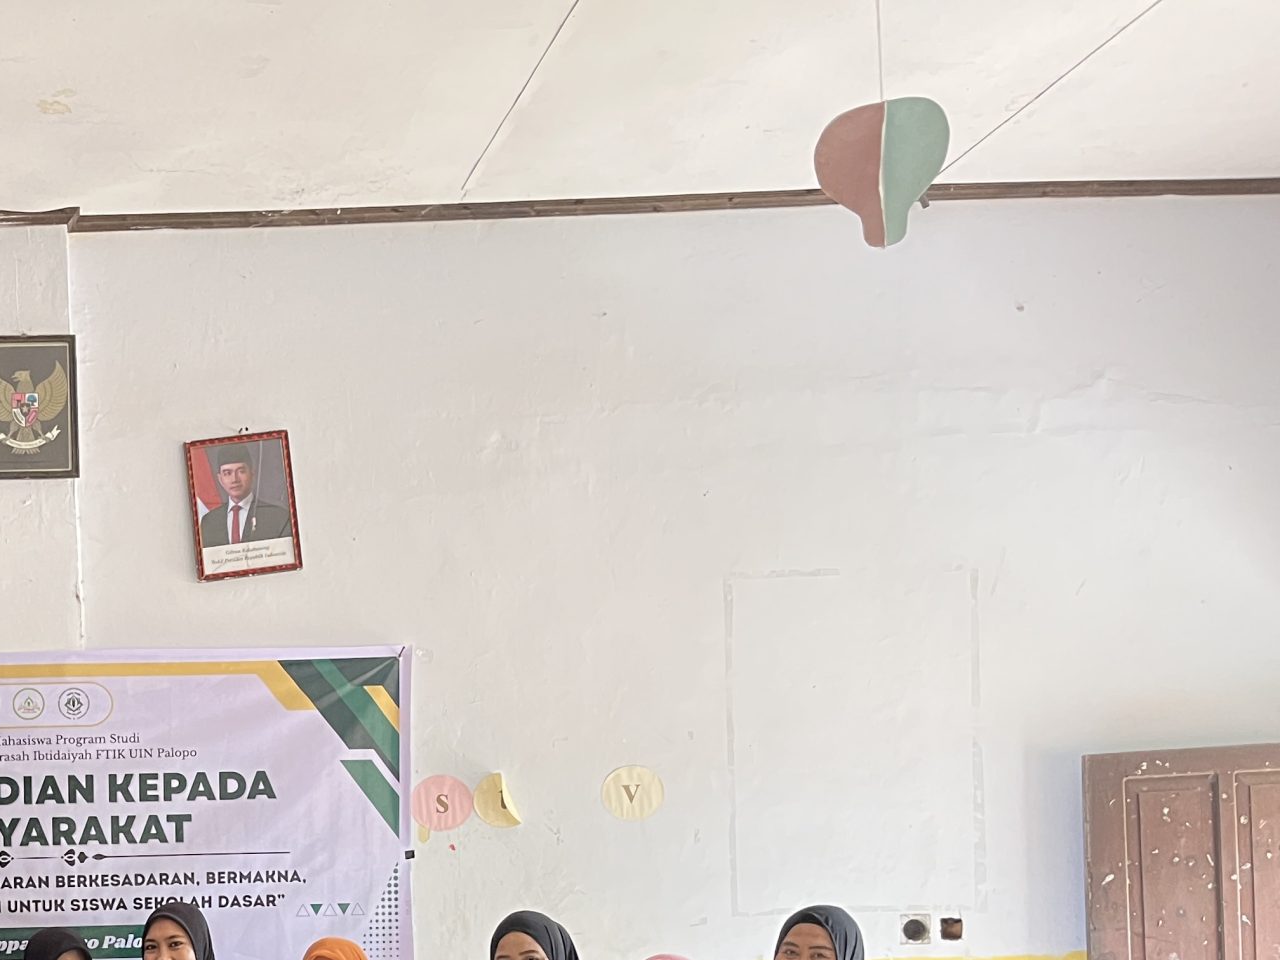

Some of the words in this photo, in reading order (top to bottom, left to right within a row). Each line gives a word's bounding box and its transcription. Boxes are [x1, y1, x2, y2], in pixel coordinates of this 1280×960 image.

[55, 734, 106, 747] Program
[109, 733, 140, 744] Studi
[33, 749, 92, 763] Ibtidaiyah
[96, 749, 126, 760] FTIK
[129, 748, 153, 759] UIN
[157, 747, 197, 760] Palopo
[108, 770, 277, 803] KEPADA
[435, 793, 449, 813] s
[55, 872, 200, 888] BERKESADARAN,
[206, 870, 307, 885] BERMAKNA,
[7, 899, 65, 913] UNTUK
[70, 897, 128, 912] SISWA
[102, 934, 143, 949] Palo
